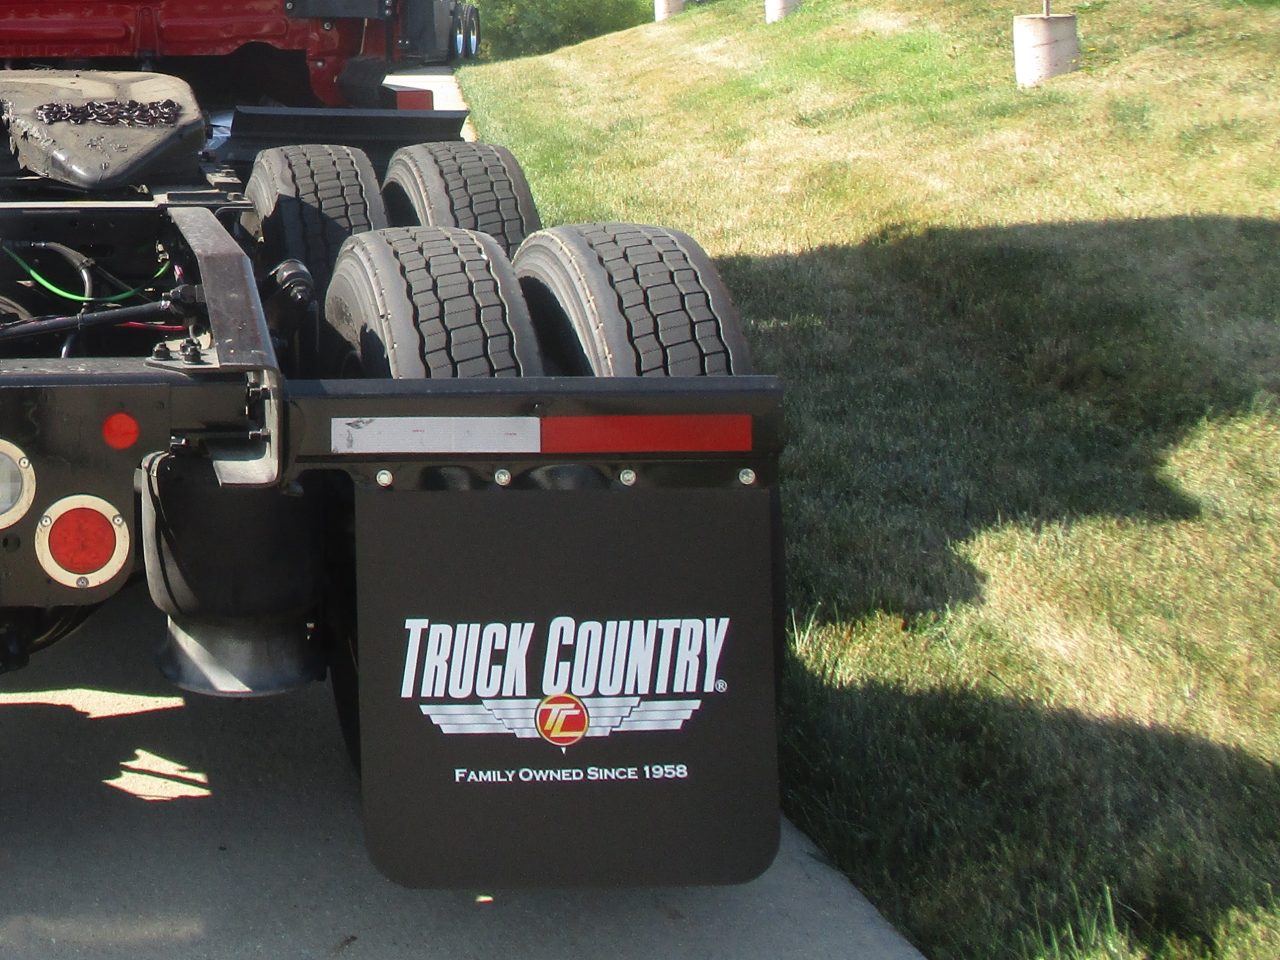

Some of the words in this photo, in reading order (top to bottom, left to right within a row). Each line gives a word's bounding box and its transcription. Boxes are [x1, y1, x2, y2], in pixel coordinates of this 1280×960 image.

[400, 618, 536, 699] TRUCK
[454, 767, 516, 783] FAMILY
[518, 766, 584, 782] OWNED
[586, 765, 639, 781] SINCE
[643, 763, 689, 780] 1958
